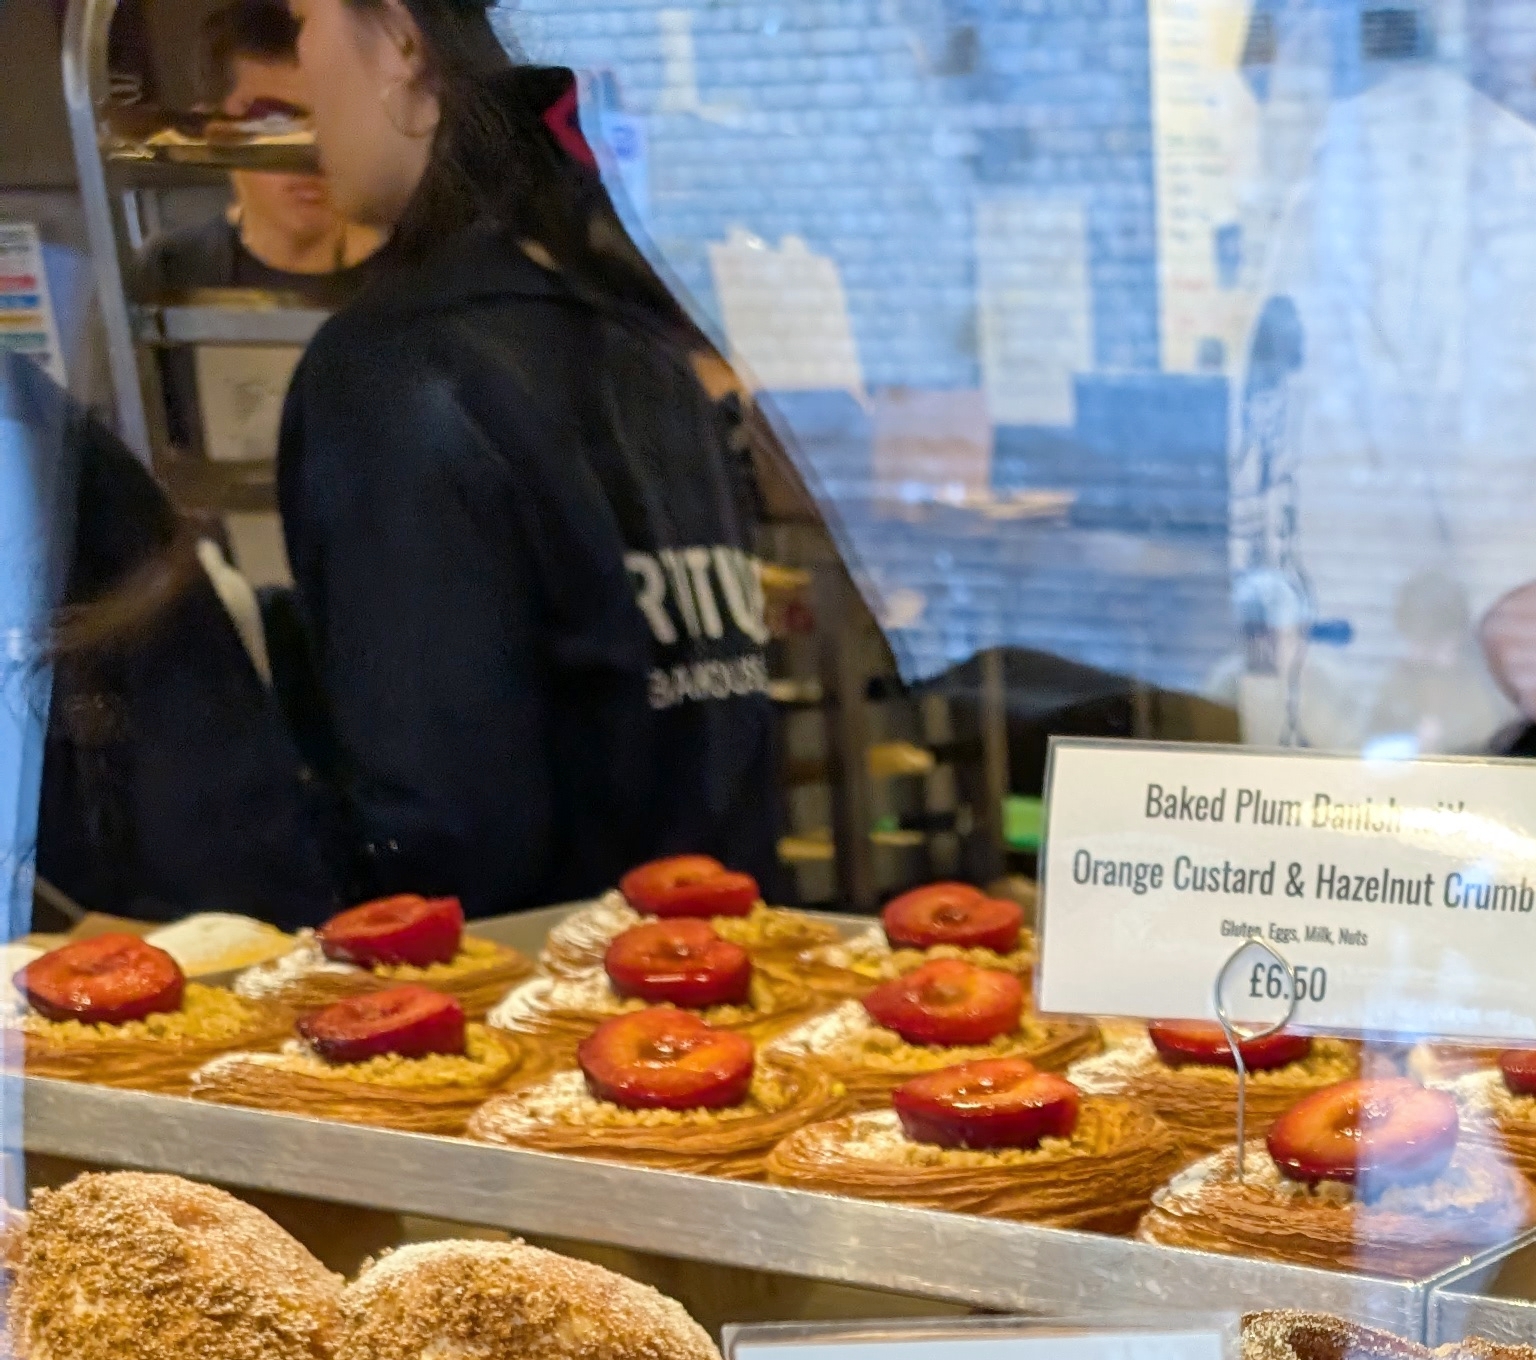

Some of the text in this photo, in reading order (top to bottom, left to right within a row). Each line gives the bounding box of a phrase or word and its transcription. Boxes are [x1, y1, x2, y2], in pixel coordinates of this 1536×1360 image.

[1145, 783, 1226, 823] Baked
[1234, 789, 1302, 827] Plum
[1072, 849, 1534, 913] Orange Custard & Hazelnut Crumb
[1268, 923, 1300, 944] Eggs,
[1304, 925, 1335, 946] Milk,
[1338, 927, 1368, 947] Nuts
[1249, 962, 1326, 1002] £6.50
